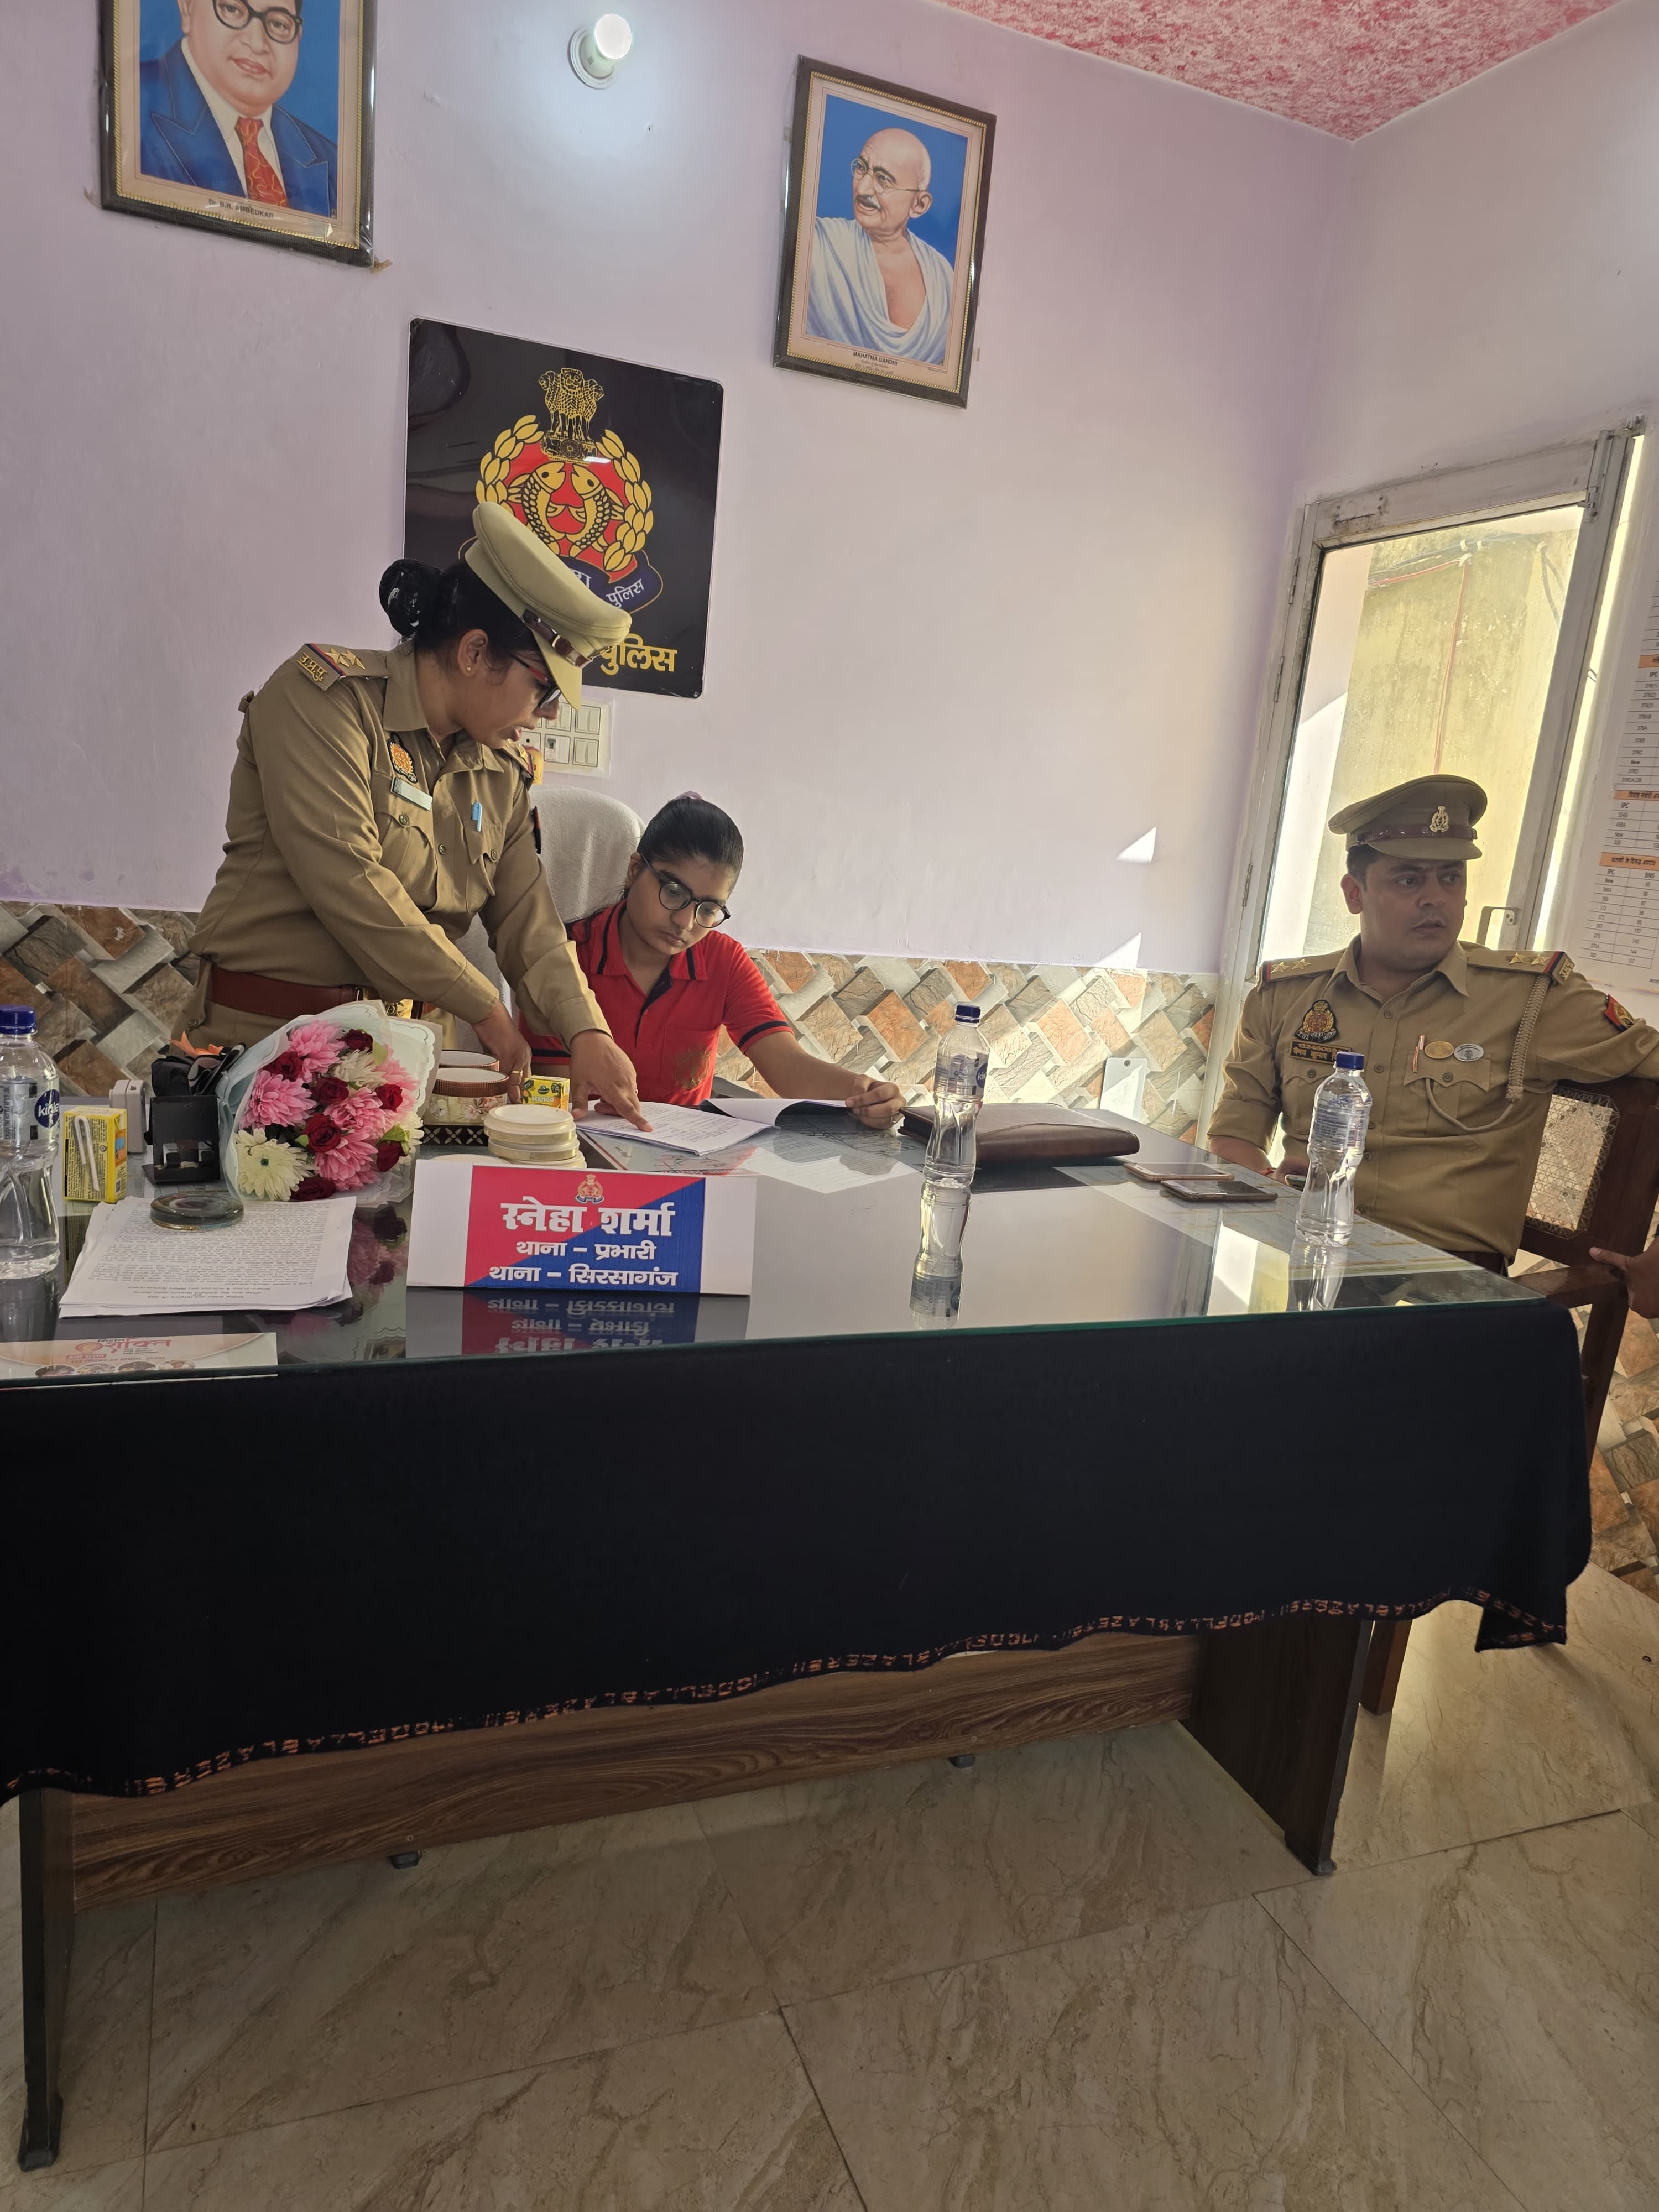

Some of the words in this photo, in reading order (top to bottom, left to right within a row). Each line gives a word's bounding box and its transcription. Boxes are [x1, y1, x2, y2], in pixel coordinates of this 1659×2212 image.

[235, 205, 274, 218] AMBEDKAR
[853, 351, 877, 361] MAHATMA
[879, 356, 898, 366] GANDHI
[606, 578, 645, 608] पुलिस
[500, 1196, 587, 1233] स्नेहा
[598, 1202, 676, 1237] शर्मा
[516, 1241, 567, 1256] थाना
[594, 1240, 656, 1260] प्रभारी
[489, 1266, 541, 1281] थाना
[569, 1263, 678, 1286] सिरसागंज
